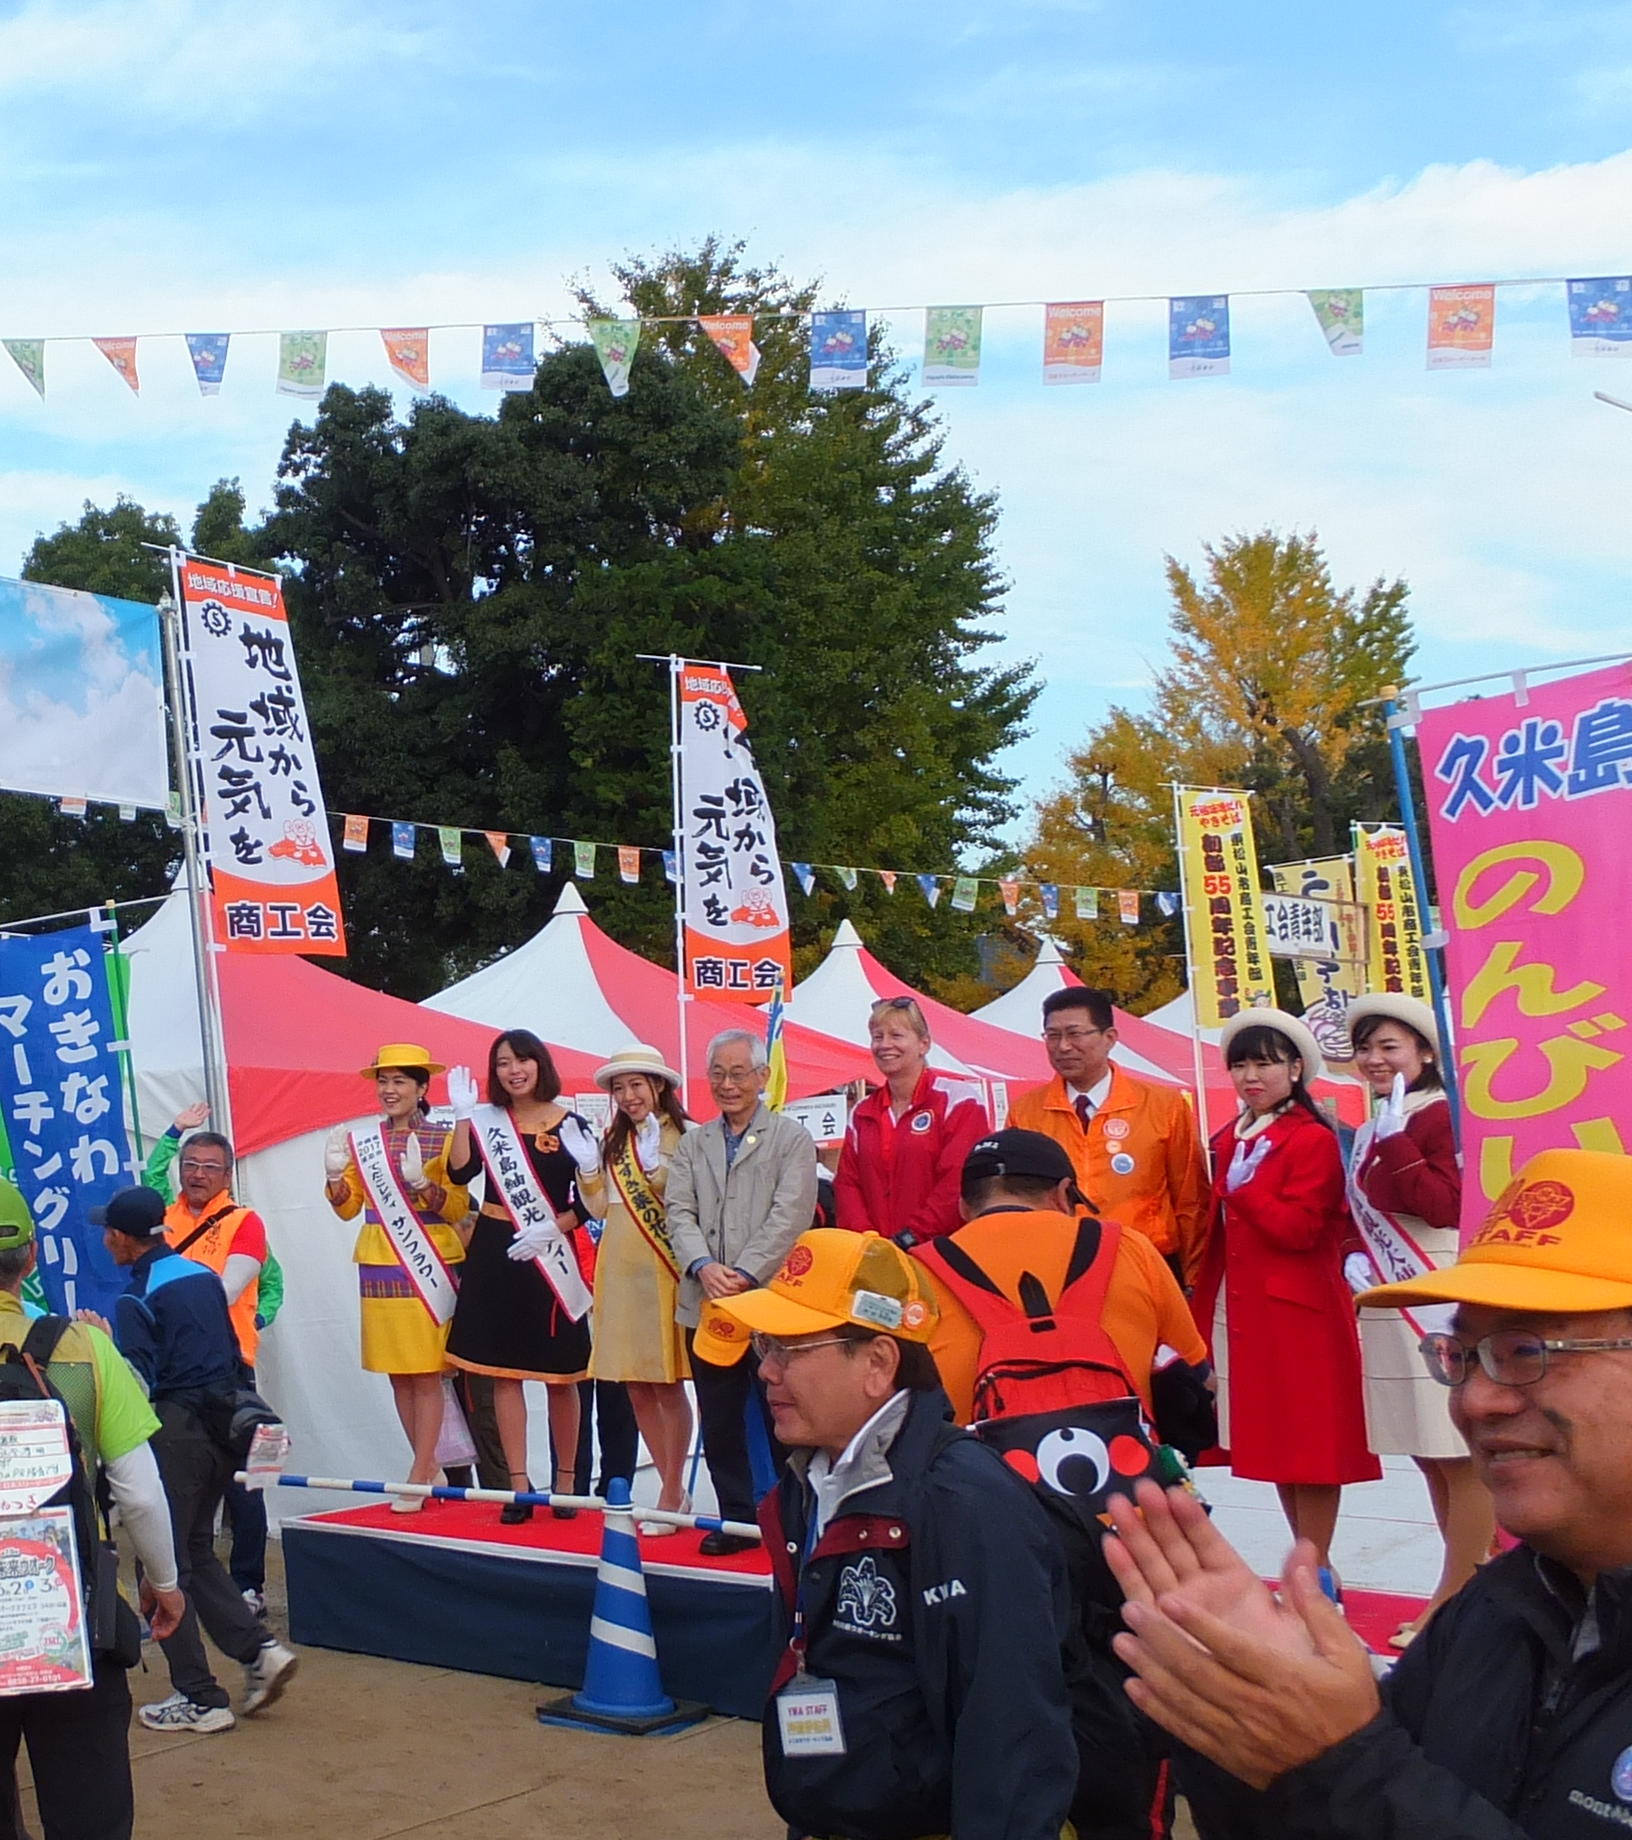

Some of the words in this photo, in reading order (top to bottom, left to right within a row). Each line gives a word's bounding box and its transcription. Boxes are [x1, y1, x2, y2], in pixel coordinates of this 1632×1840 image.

[1047, 306, 1101, 319] Welcome
[239, 622, 317, 817] 地域から
[1440, 702, 1632, 818] 久米島
[210, 709, 272, 865] 元気を
[225, 901, 339, 941] 商工会
[692, 794, 732, 926] 元気を
[694, 958, 784, 989] 商工会
[40, 948, 119, 1184] おきなわ
